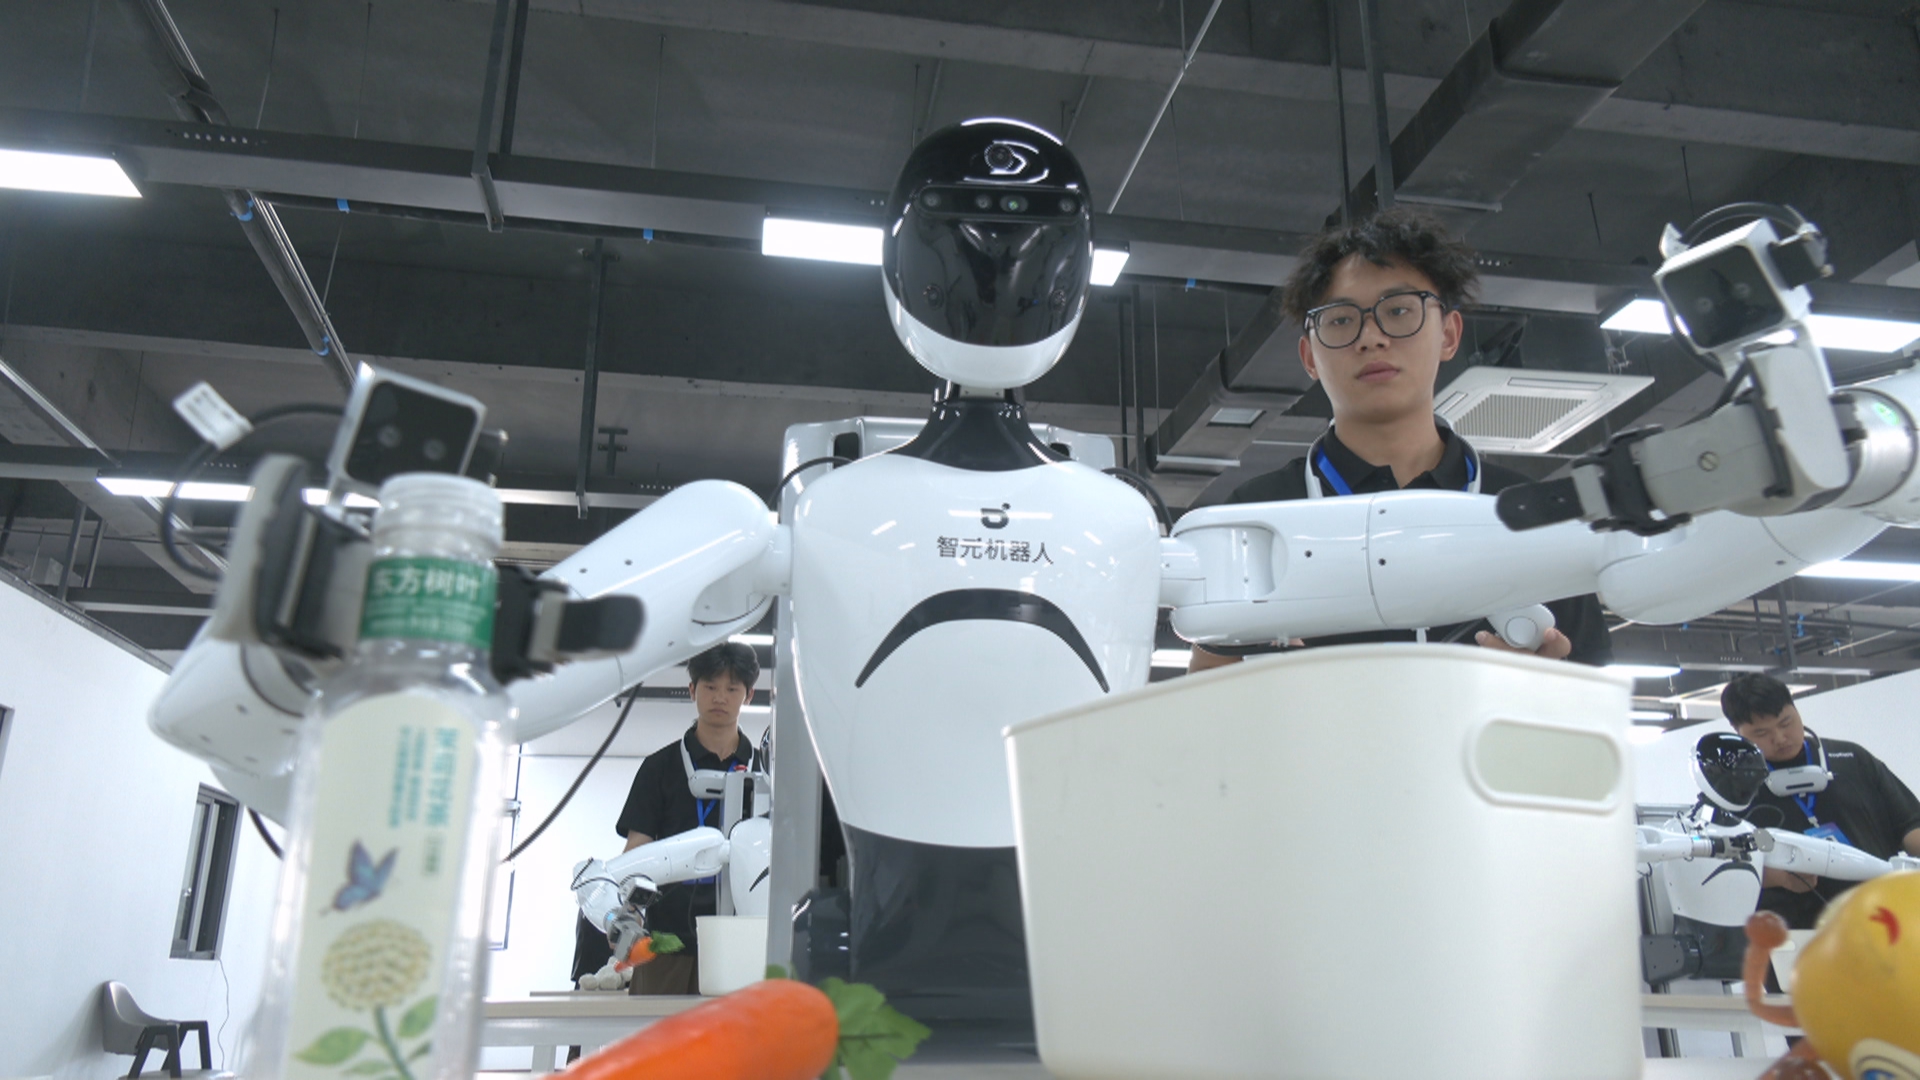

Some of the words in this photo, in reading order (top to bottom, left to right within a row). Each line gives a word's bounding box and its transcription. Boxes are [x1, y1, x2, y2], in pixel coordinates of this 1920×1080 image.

[936, 535, 1054, 565] 智元机器人
